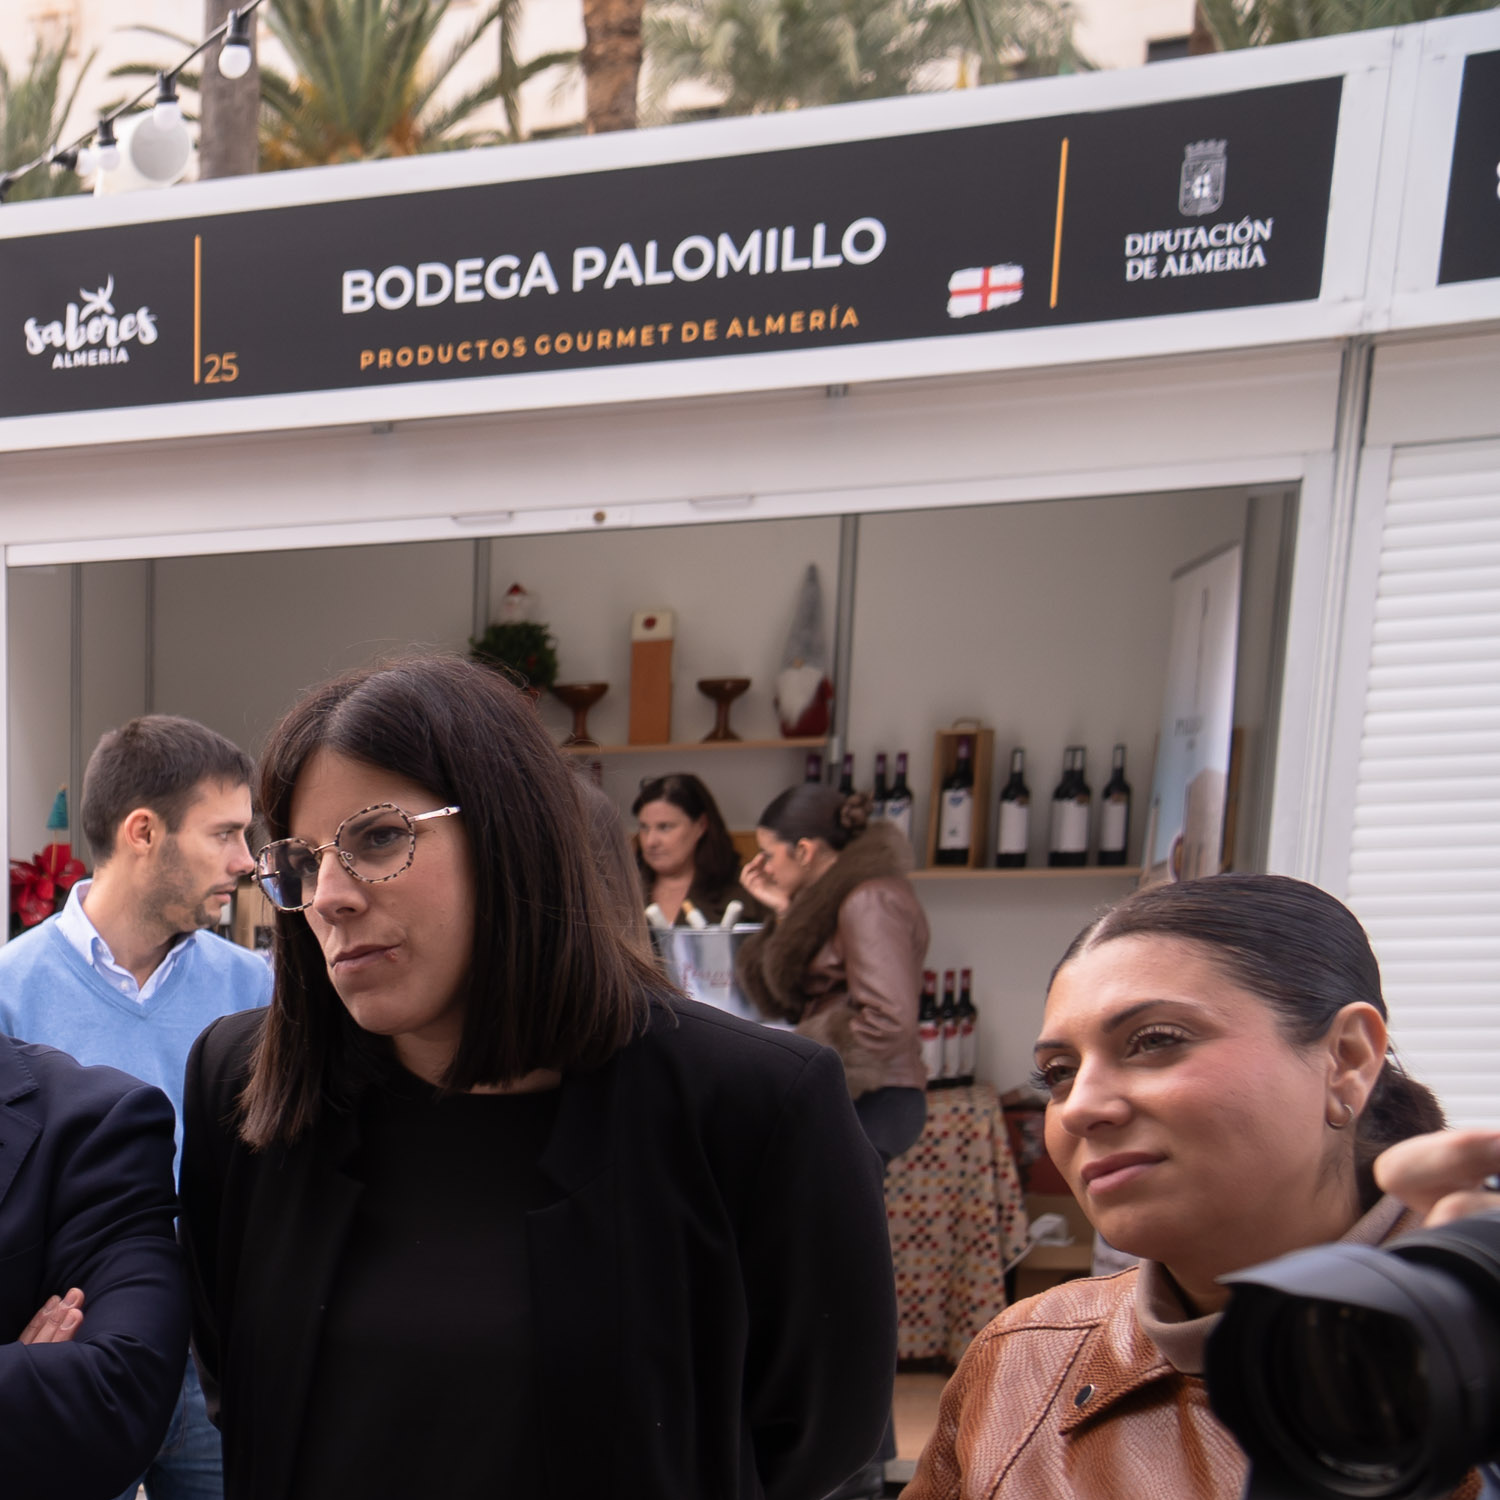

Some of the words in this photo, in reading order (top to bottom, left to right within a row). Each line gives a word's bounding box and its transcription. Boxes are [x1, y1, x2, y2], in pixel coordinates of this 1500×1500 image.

[1125, 216, 1275, 258] DIPUTACIÓN
[341, 251, 559, 314] BODEGA
[571, 216, 887, 293] PALOMILLO
[1126, 257, 1158, 282] DE
[1160, 244, 1267, 280] ALMERÍA
[359, 335, 528, 371] PRODUCTOS
[534, 323, 673, 357] GOURMET
[681, 319, 718, 343] DE
[725, 304, 860, 340] ALMERÍA
[52, 346, 130, 370] ALMERÍA
[203, 352, 240, 385] 25
